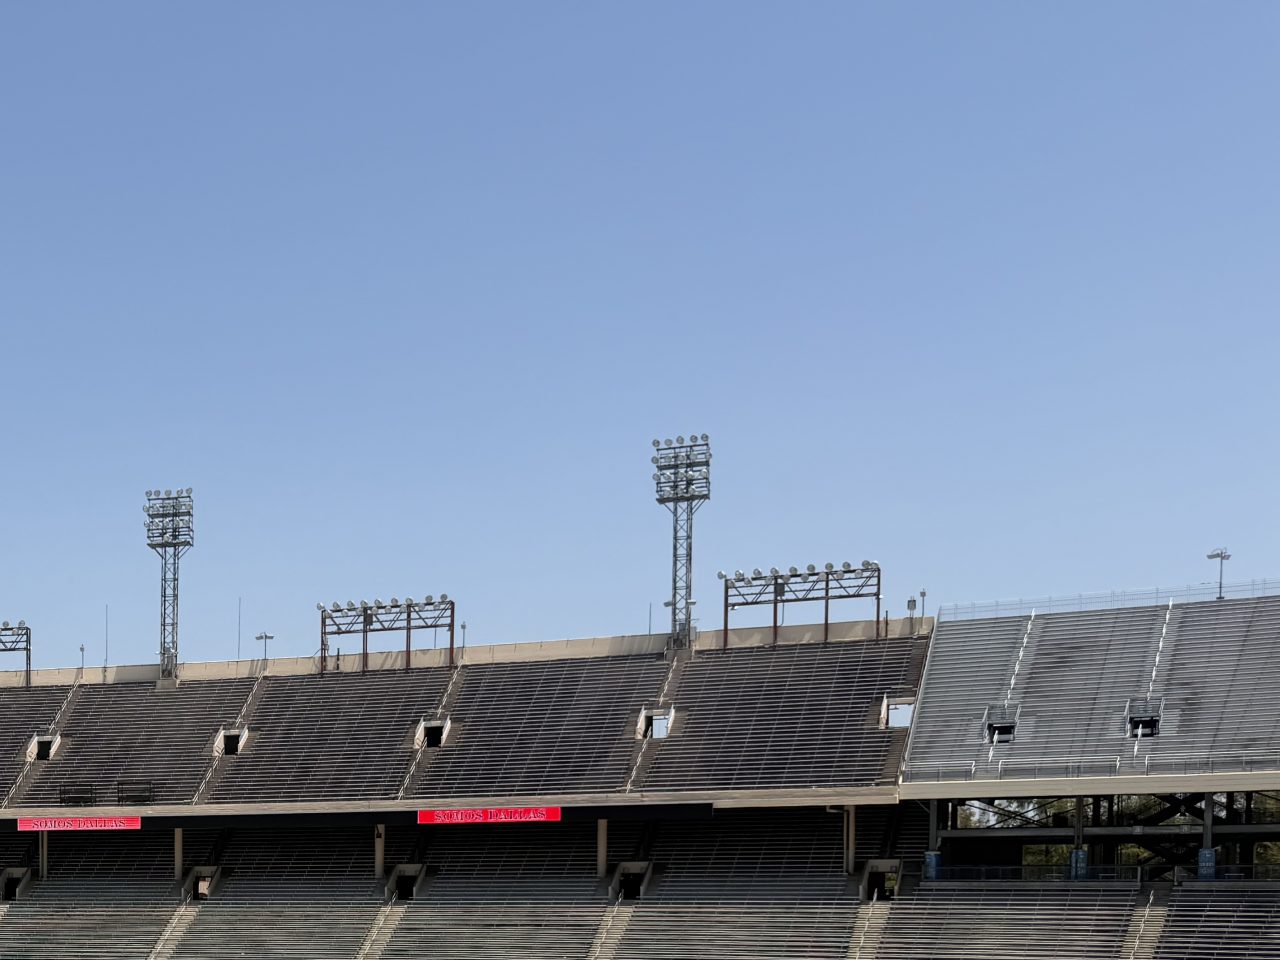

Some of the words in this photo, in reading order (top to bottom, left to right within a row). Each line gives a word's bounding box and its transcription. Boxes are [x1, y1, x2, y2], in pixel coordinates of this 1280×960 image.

[435, 810, 483, 821] SOMOS
[488, 808, 546, 820] DALLAS
[32, 819, 74, 829] SOMOS
[78, 819, 126, 828] DALLAS
